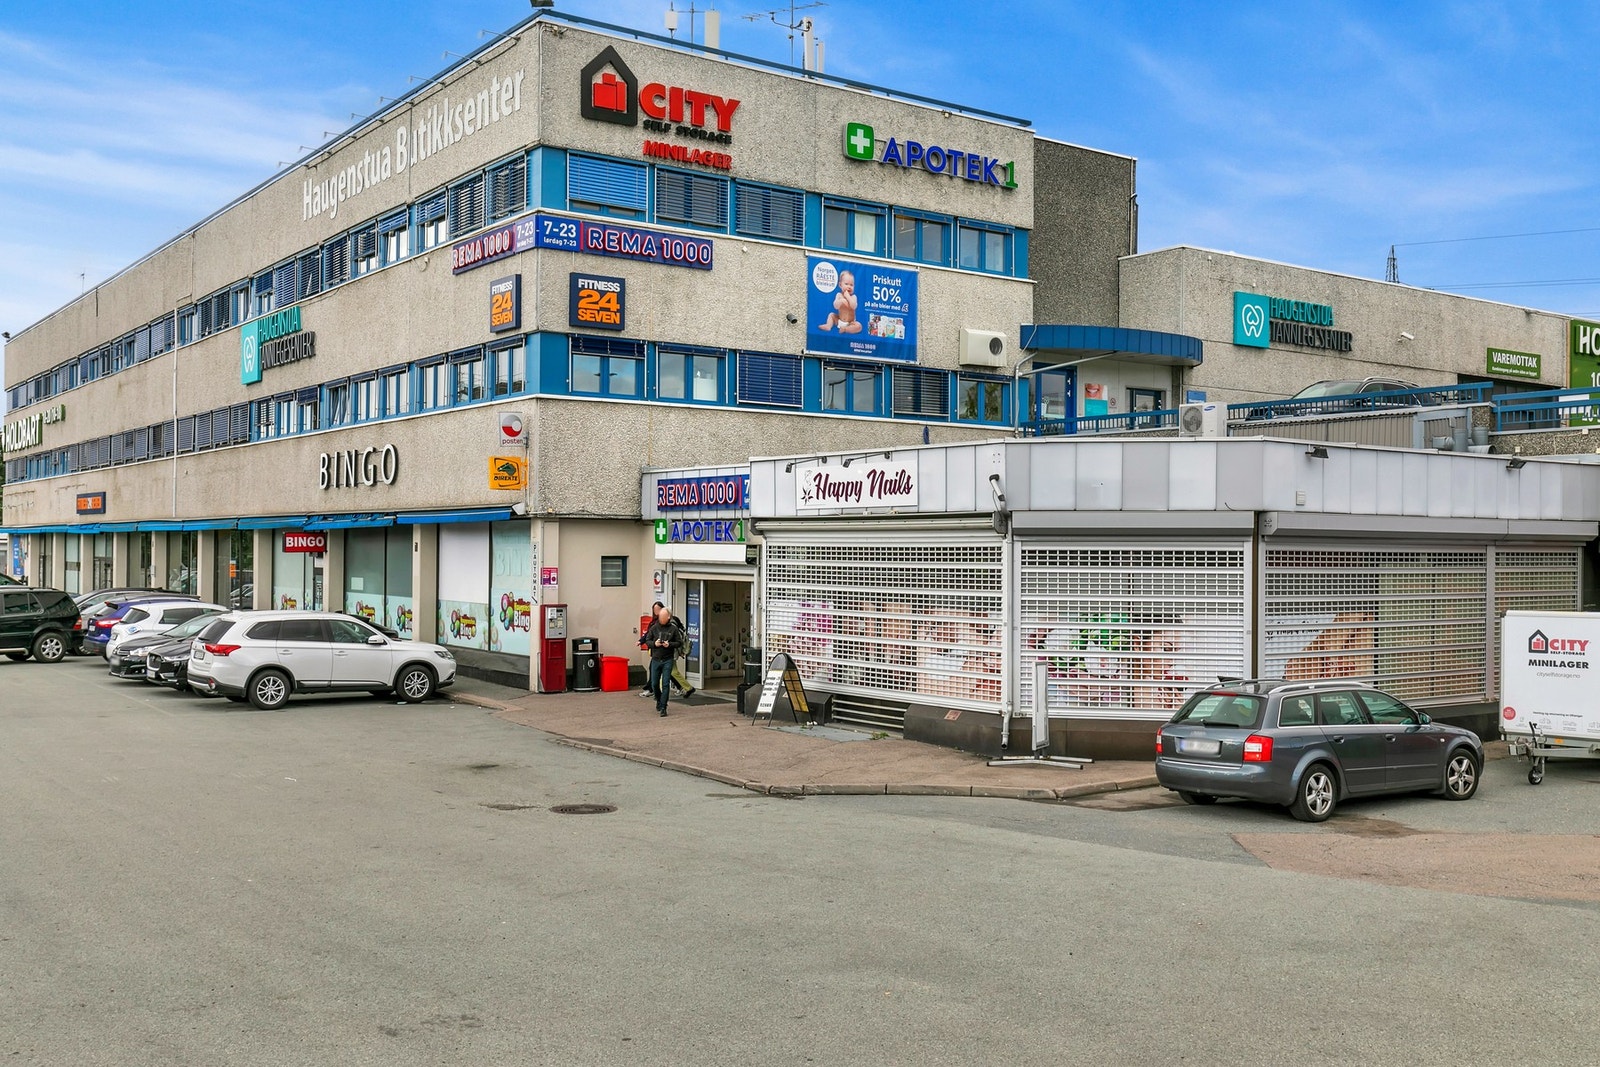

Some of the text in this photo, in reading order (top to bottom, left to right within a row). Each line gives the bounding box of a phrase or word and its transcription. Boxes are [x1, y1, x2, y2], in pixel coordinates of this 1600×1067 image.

[639, 82, 741, 132] CITY
[643, 119, 732, 144] SELF STORAGE
[302, 68, 525, 221] Haugenstua Butikksenter
[643, 140, 732, 169] MINILAGER
[881, 137, 1000, 185] APOTEK
[544, 221, 576, 237] 7-23
[452, 239, 482, 268] REMA
[483, 229, 510, 257] 1000
[517, 221, 534, 239] 7-23
[588, 228, 711, 263] REMA 1000
[491, 281, 513, 295] FITNESS
[578, 278, 620, 292] FITNESS
[872, 274, 902, 287] Priskutt
[491, 291, 513, 314] 24
[578, 289, 620, 312] 24
[872, 286, 902, 304] 50%
[491, 310, 513, 326] SEVEN
[578, 309, 620, 324] SEVEN
[1270, 297, 1334, 326] HAUGENSTUA
[1270, 321, 1352, 351] TANNLEGESENTER
[1492, 351, 1537, 368] VAREMOTTAK
[5, 413, 41, 453] HOLDBART
[320, 443, 397, 490] BINGO
[658, 484, 698, 506] REMA
[701, 481, 736, 505] 1000
[813, 468, 913, 503] Happy Nails
[285, 536, 324, 548] BINGO
[671, 521, 733, 542] APOTEK
[1549, 639, 1589, 651] CITY
[1528, 659, 1589, 669] MINILAGER
